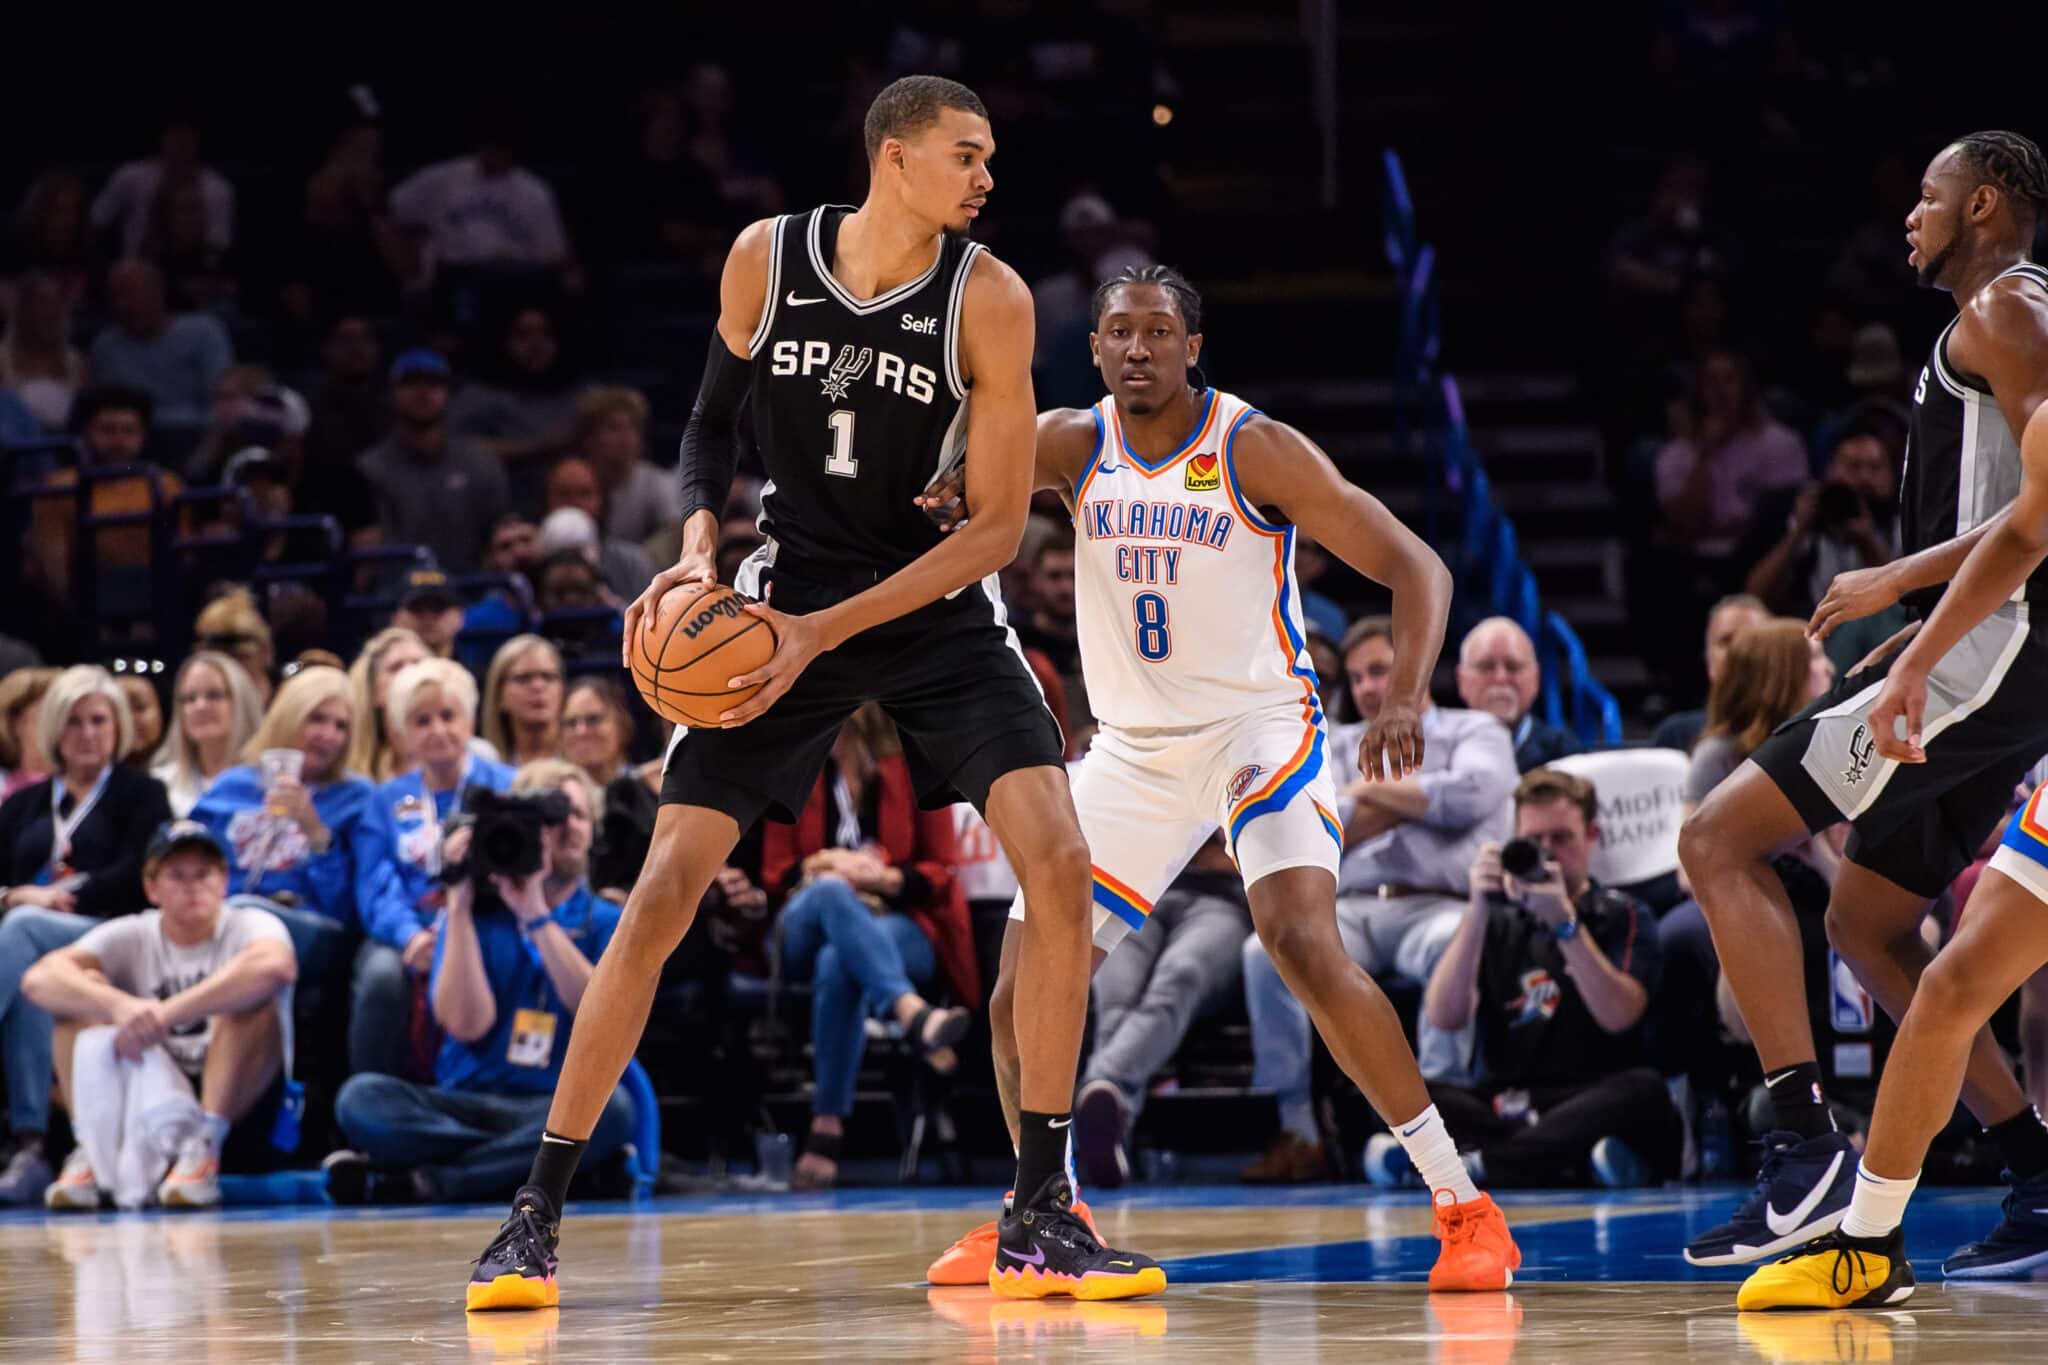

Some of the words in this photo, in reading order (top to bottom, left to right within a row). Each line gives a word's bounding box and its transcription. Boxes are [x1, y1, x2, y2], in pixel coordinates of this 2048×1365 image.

[824, 409, 859, 479] 1
[1082, 499, 1235, 552] OKLAHOMA
[1115, 544, 1182, 585] CITY
[1132, 590, 1173, 663] 8
